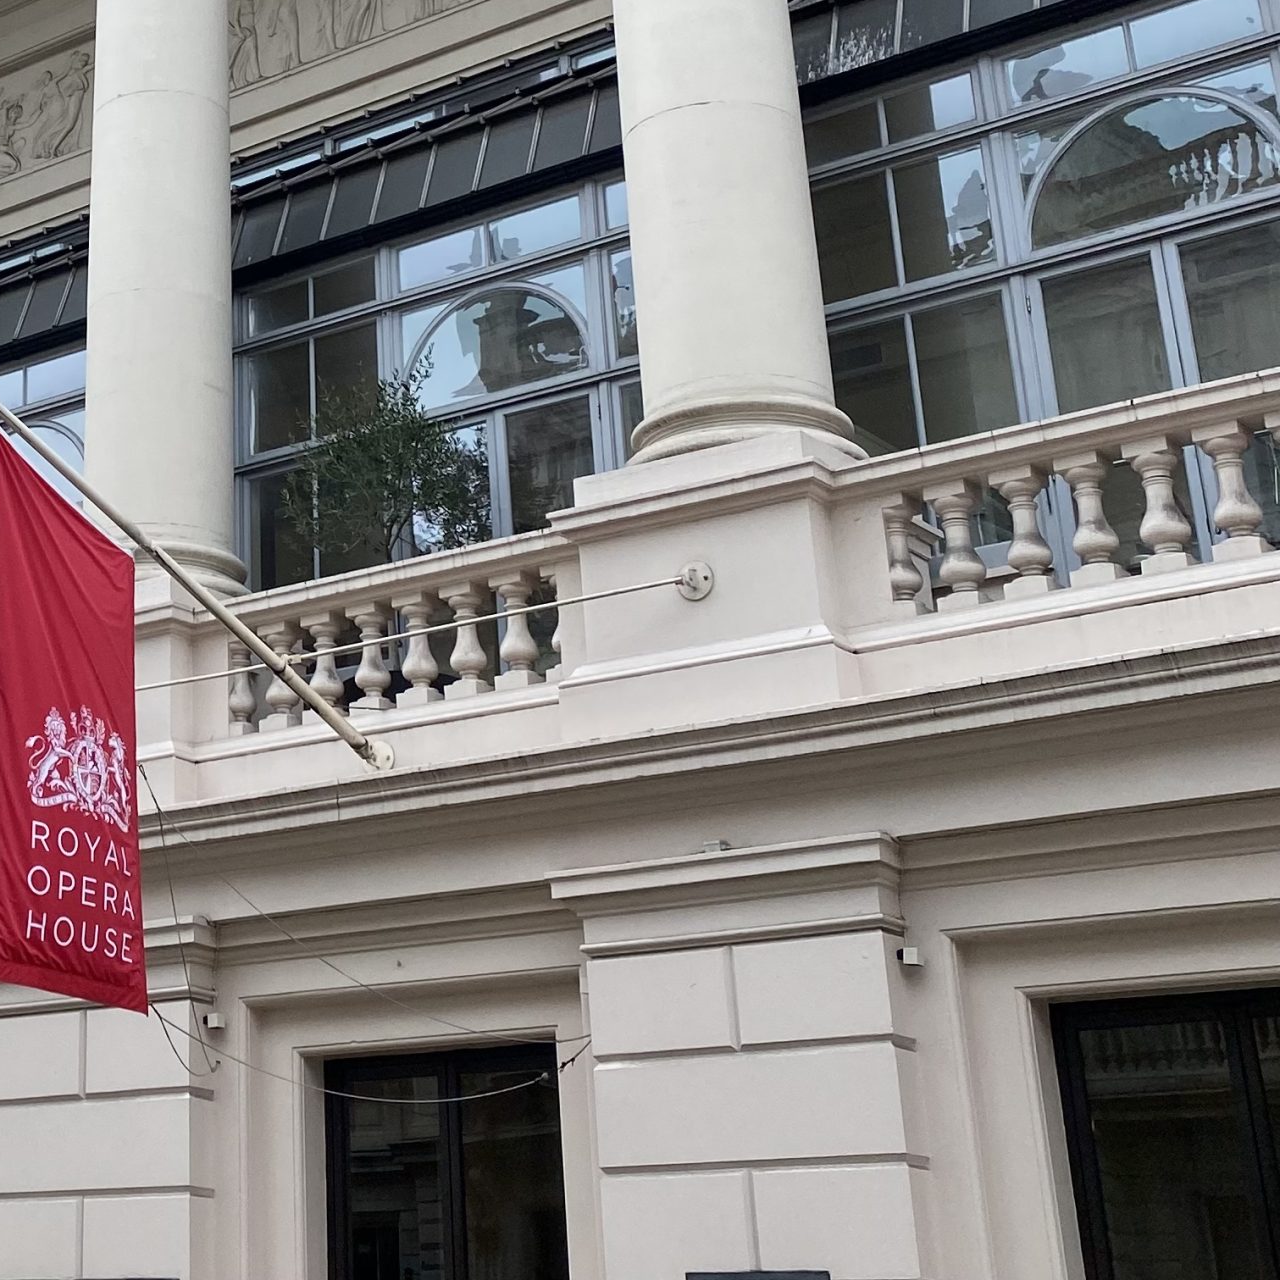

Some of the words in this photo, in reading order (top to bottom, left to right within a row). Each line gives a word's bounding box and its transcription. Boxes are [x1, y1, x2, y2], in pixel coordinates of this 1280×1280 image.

[31, 820, 131, 877] ROYAL
[27, 865, 135, 920] OPERA
[26, 909, 133, 963] HOUSE
